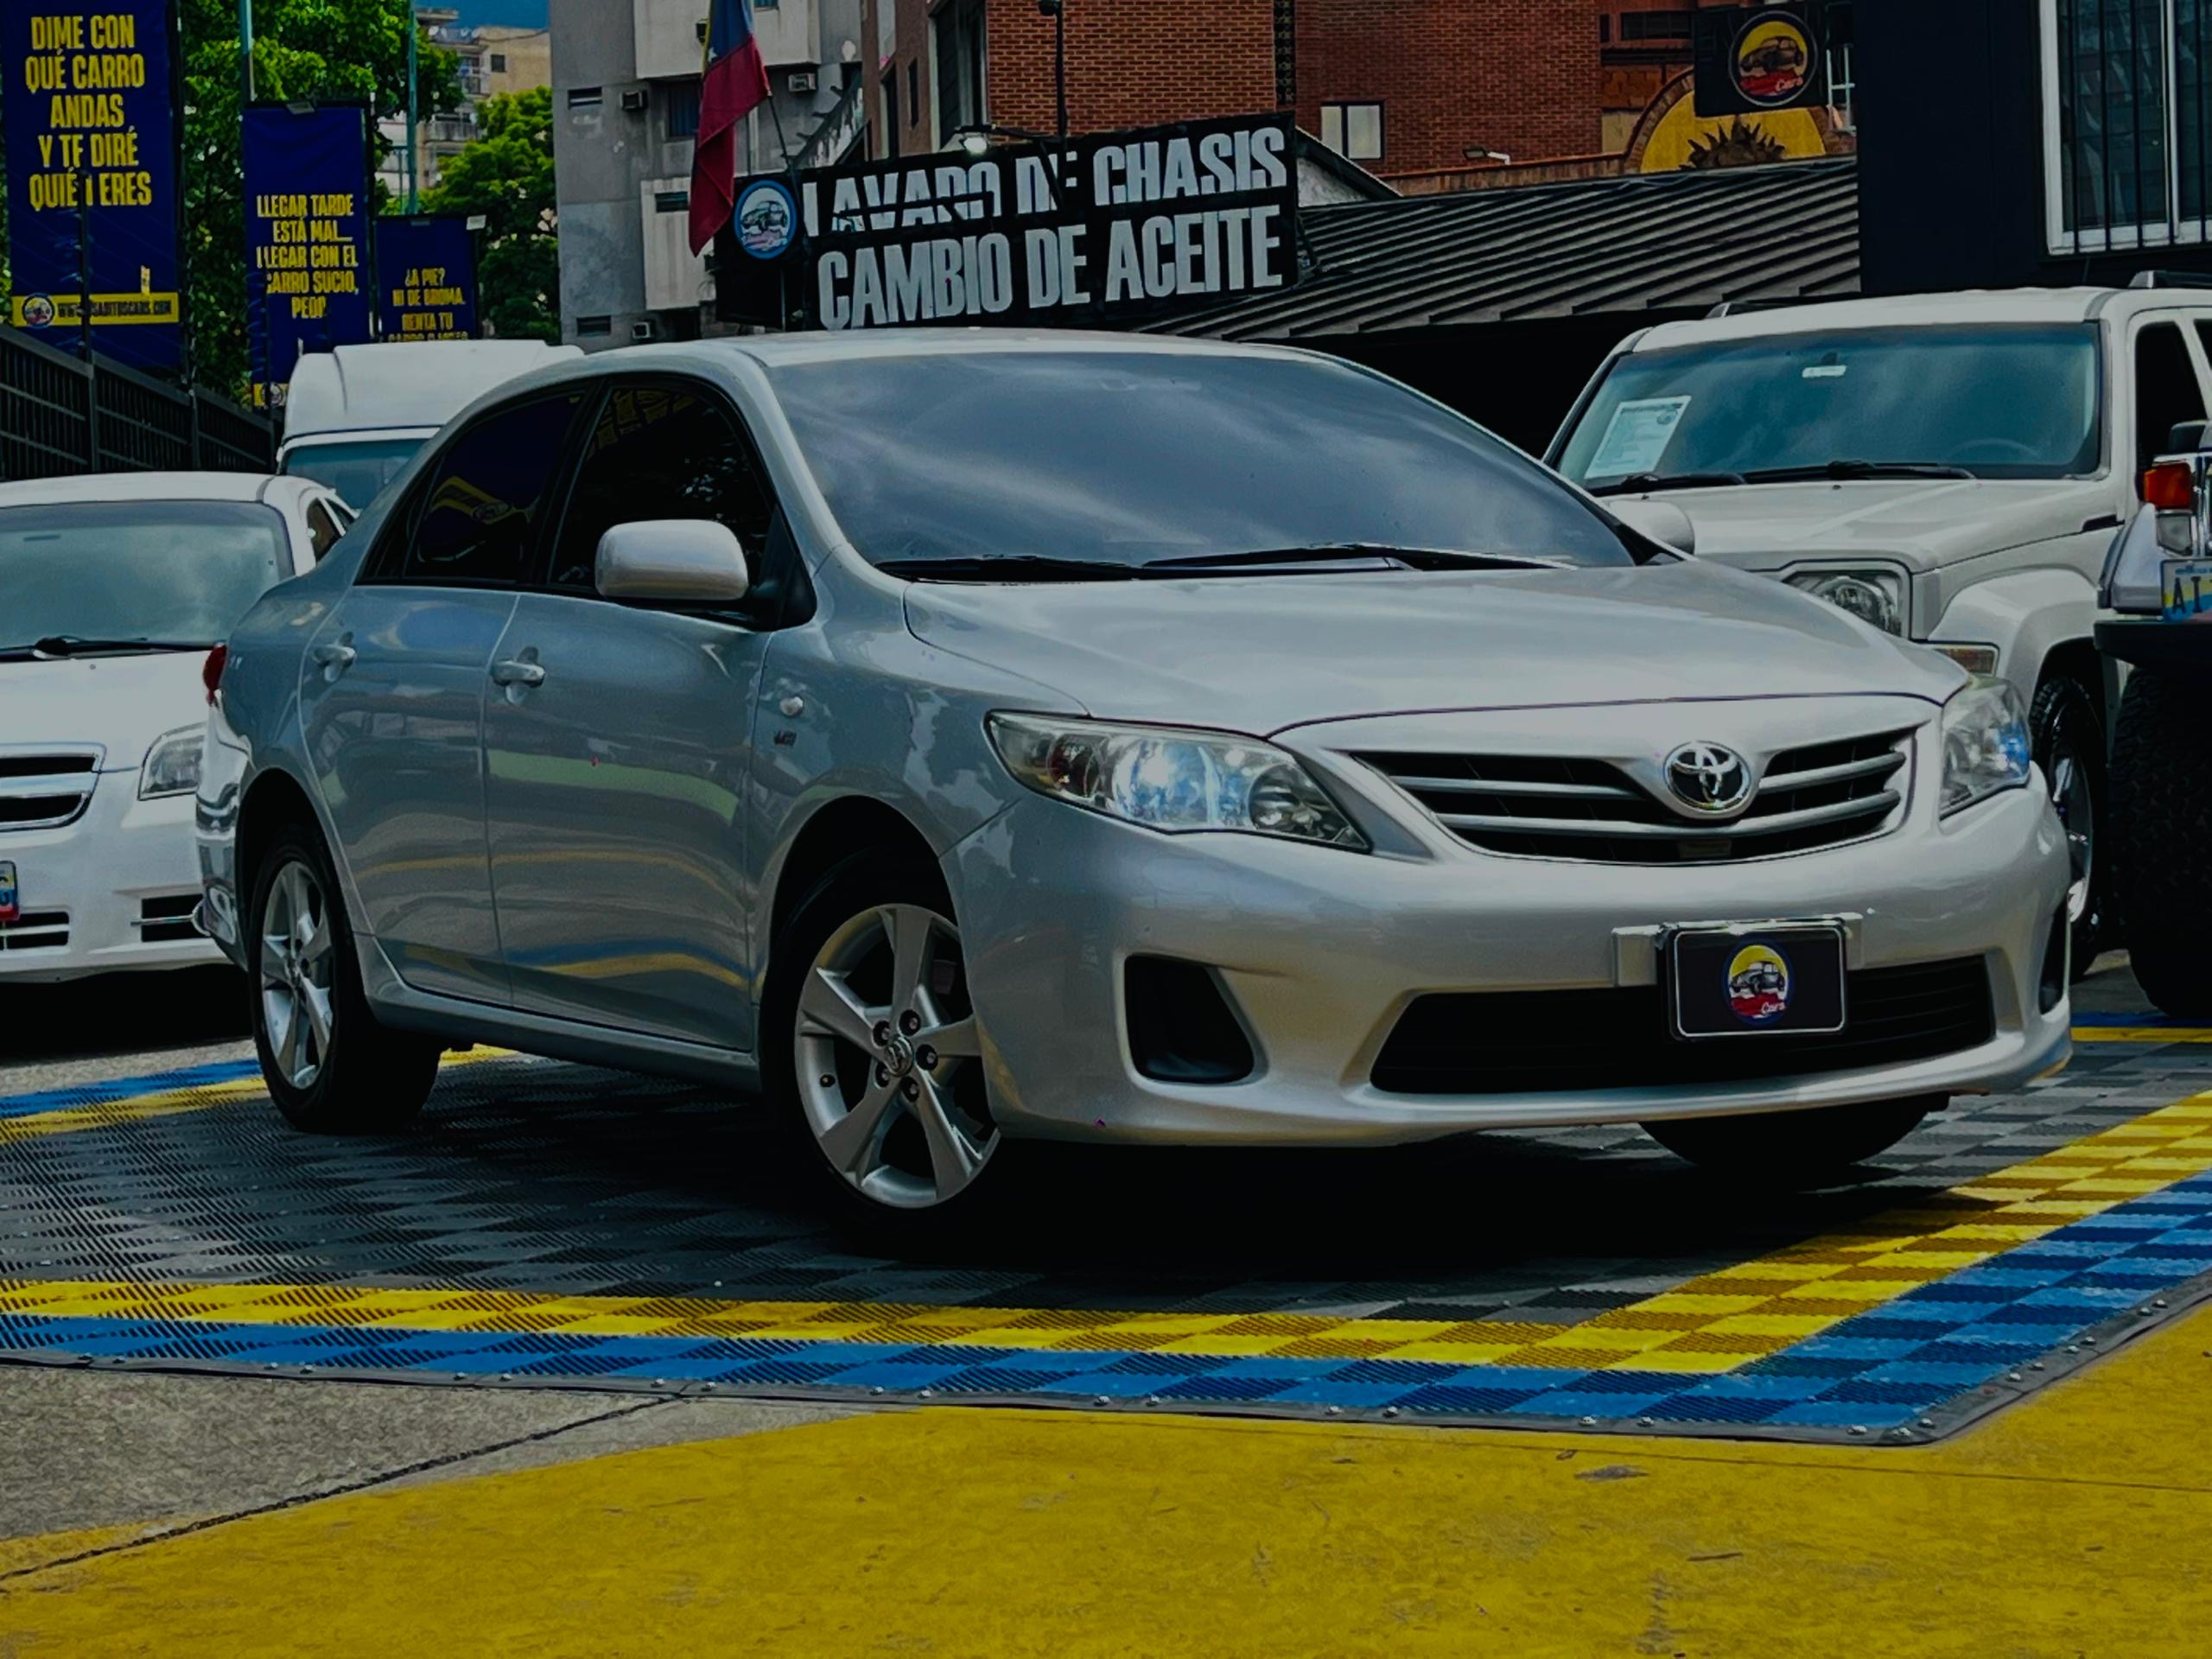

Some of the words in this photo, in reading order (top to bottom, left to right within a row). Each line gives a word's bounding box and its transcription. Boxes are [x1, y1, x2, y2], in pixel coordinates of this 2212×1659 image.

[31, 16, 84, 49] DIME
[91, 15, 135, 48] CON
[25, 48, 66, 93] QUÉ
[73, 54, 144, 88] CARRO
[51, 93, 124, 128] ANDAS
[38, 135, 53, 168] Y
[90, 126, 138, 166] DIRÉ
[1092, 126, 1287, 207] CHASIS
[100, 171, 151, 206] ERES
[257, 194, 307, 218] LLEGAR
[311, 194, 353, 215] TARDE
[274, 217, 306, 242] ESTÁ
[312, 245, 340, 267] CON
[344, 245, 358, 266] EL
[817, 232, 1014, 330] CAMBIO
[1024, 223, 1090, 308] DE
[1106, 203, 1284, 302] ACEITE
